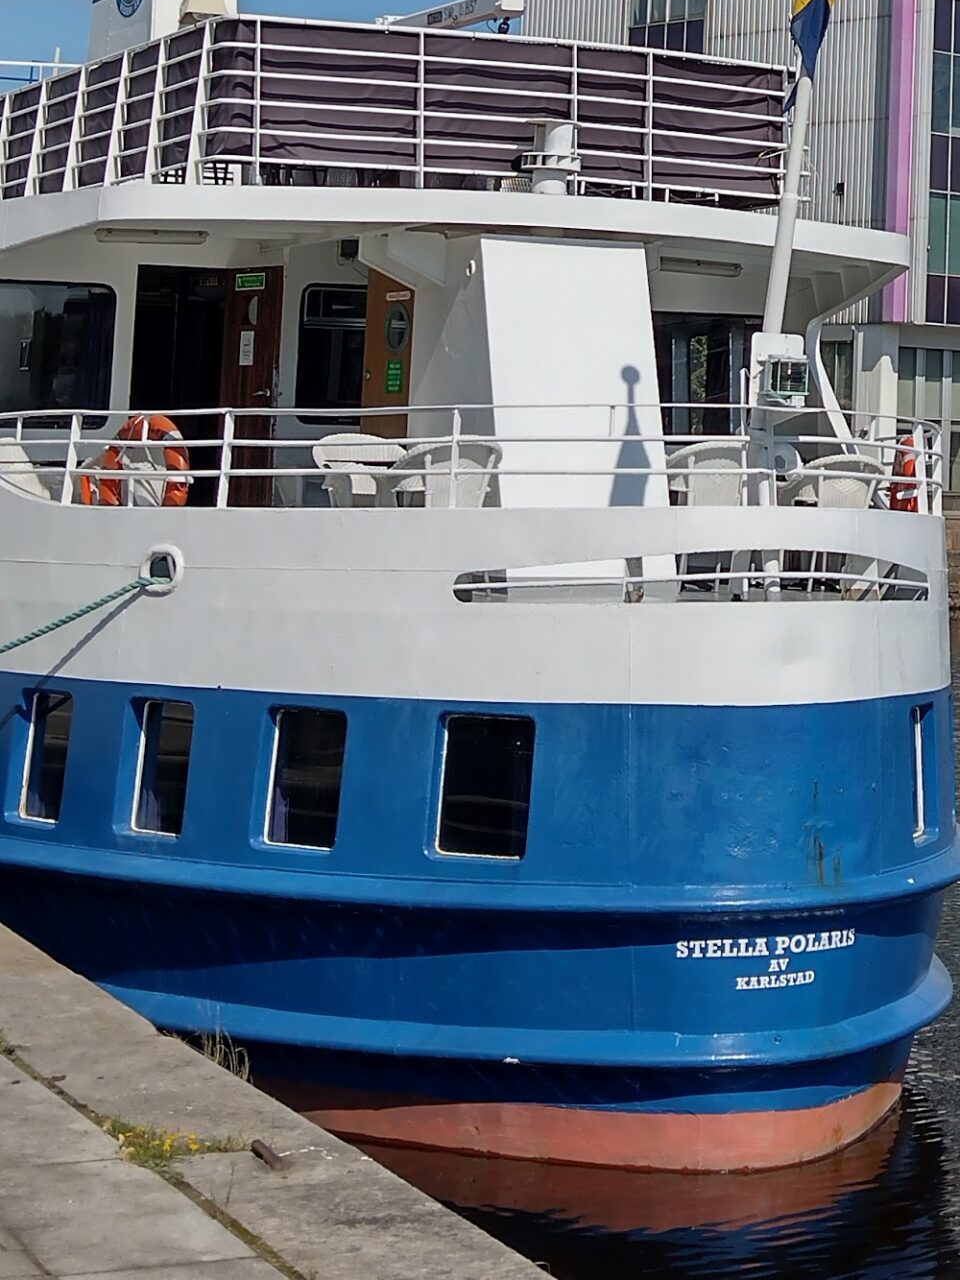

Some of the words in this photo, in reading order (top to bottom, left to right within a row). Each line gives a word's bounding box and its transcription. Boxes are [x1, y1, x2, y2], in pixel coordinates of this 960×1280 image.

[676, 937, 769, 958] STELLA
[775, 928, 856, 955] POLARIS
[768, 958, 790, 972] AV
[735, 970, 815, 990] KARLSTAD
